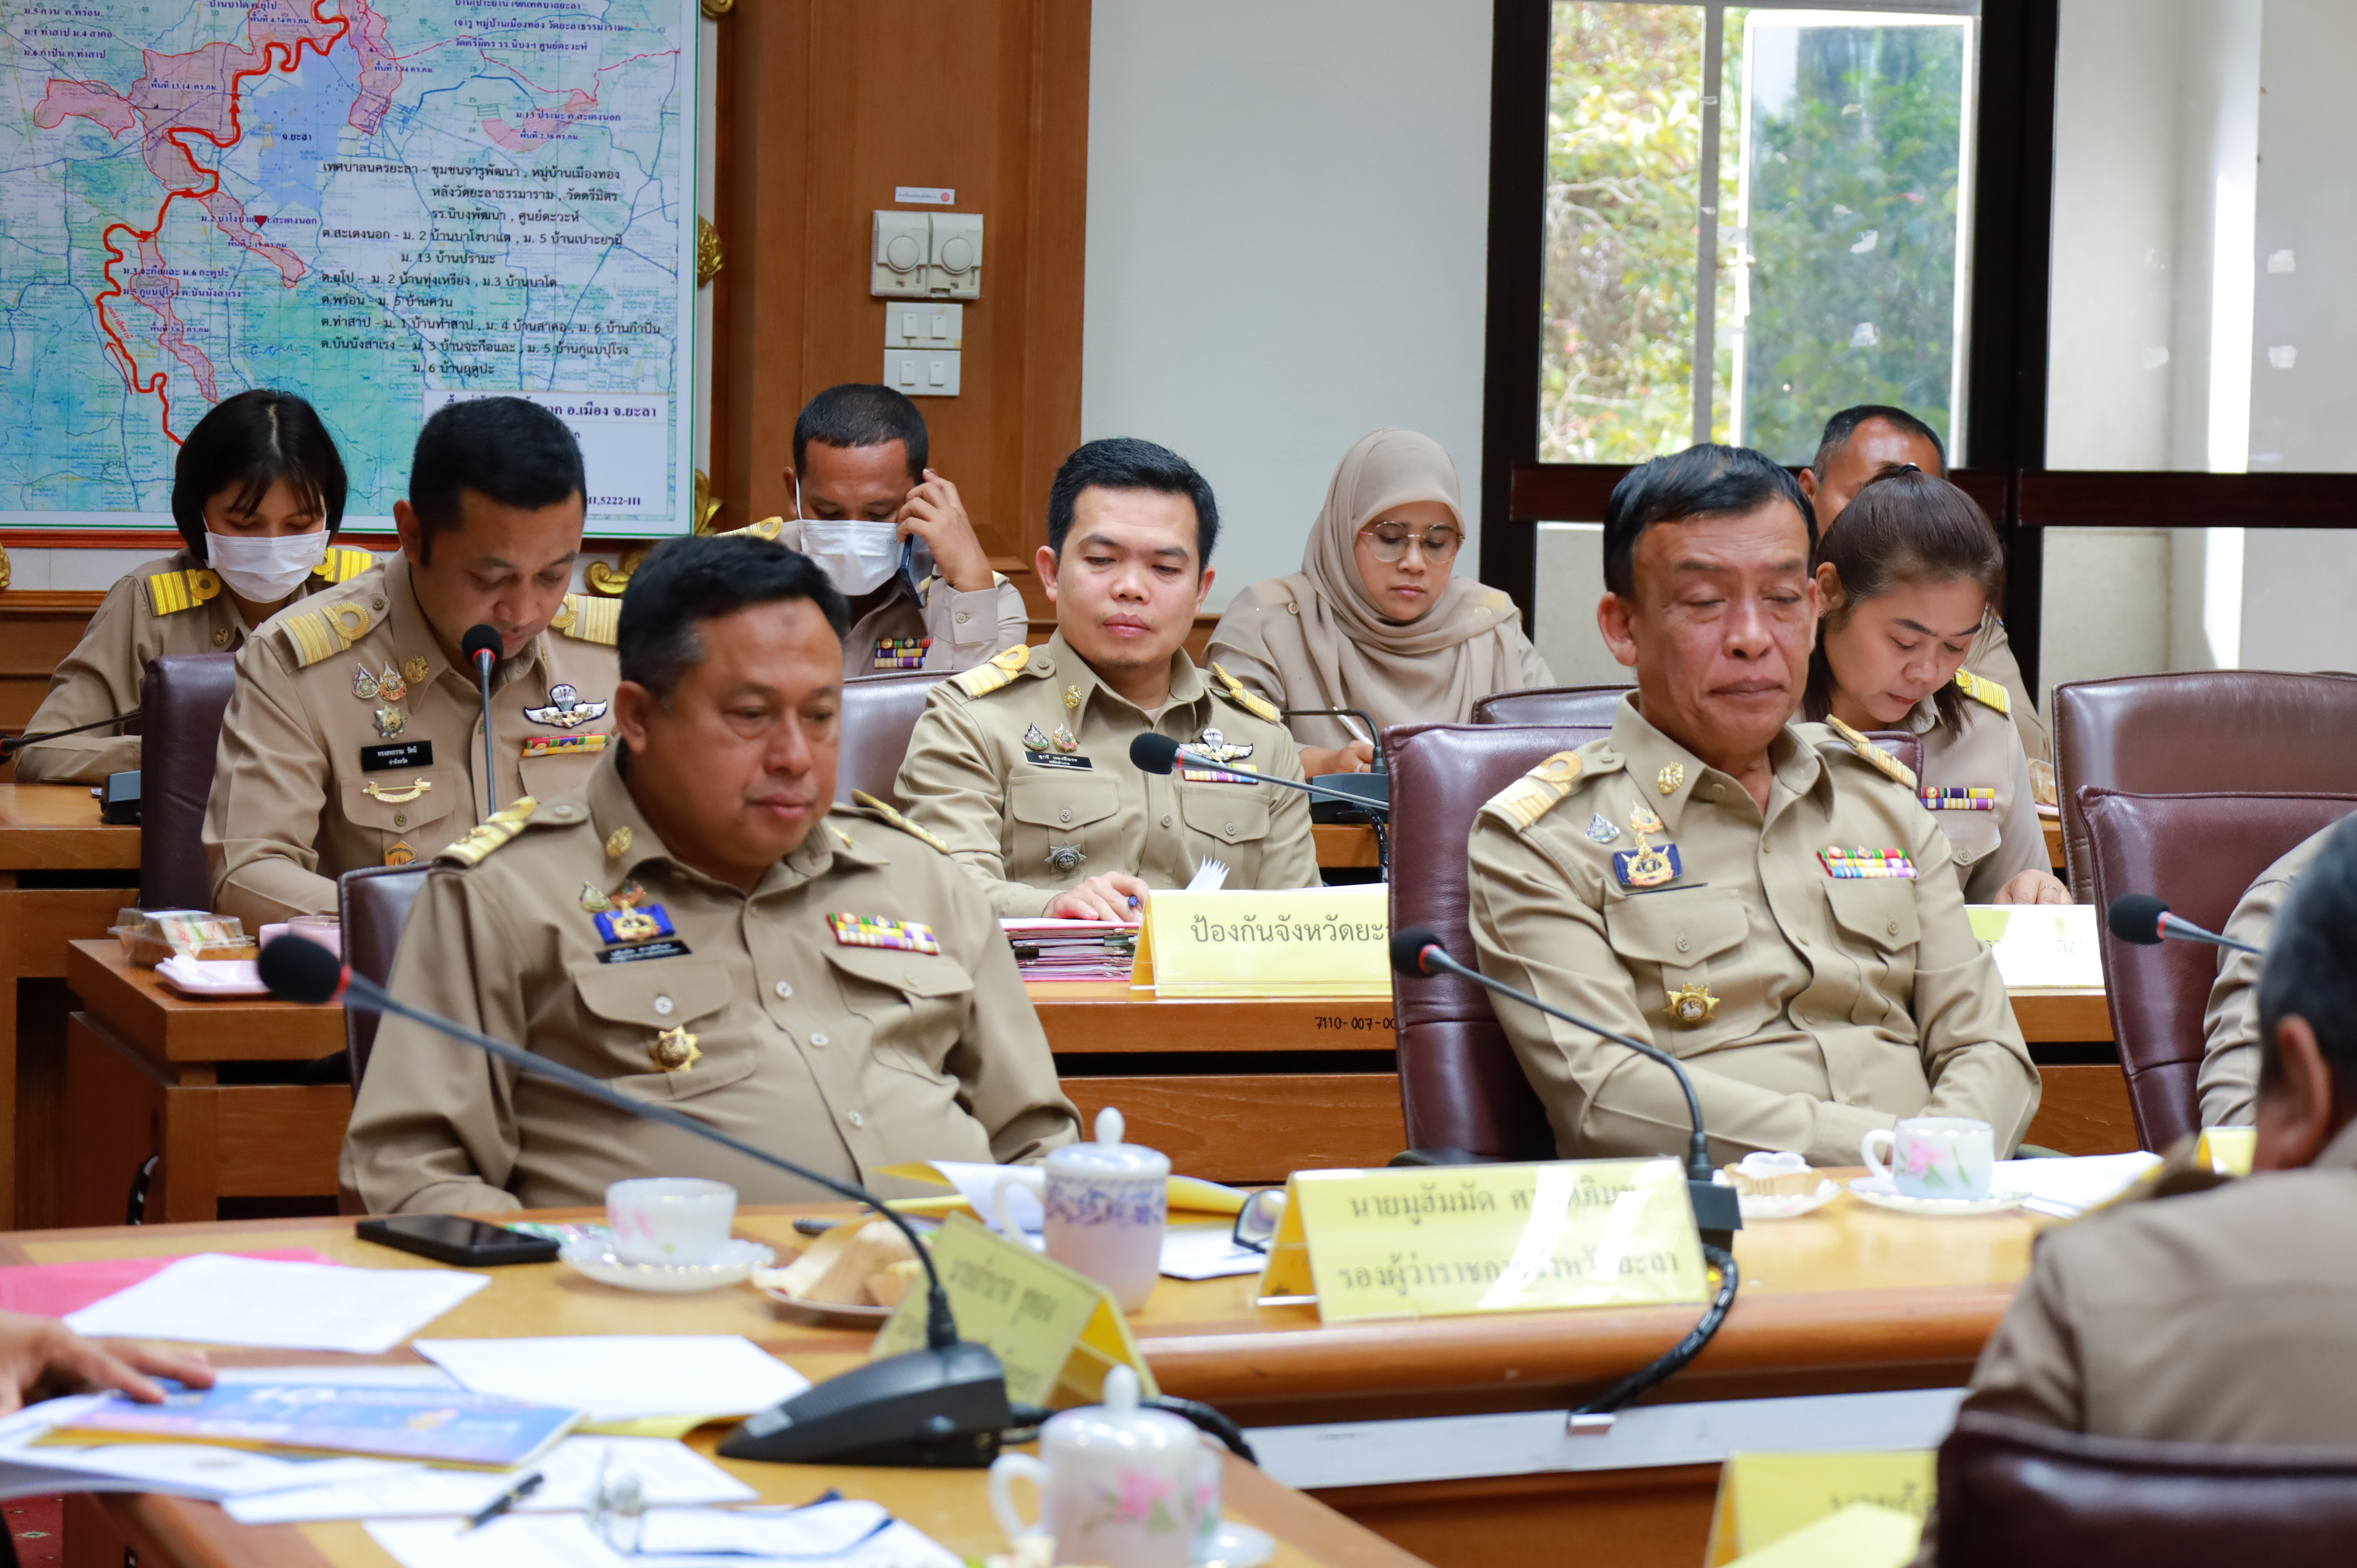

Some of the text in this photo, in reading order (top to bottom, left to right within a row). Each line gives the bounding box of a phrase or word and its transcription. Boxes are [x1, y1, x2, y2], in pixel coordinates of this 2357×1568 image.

[475, 18, 545, 29] หมู่บ้านเมืองทอง
[455, 37, 496, 48] วัดตรีมิตร
[323, 162, 620, 182] เทศบาลนครยะลา ชุมชนจารูพัฒนา หมู่บ้านเมืองทอง
[432, 184, 618, 202] หลังวัดยะลาธรรมาราม วัดตรีมิตร
[218, 212, 257, 223] บาโงบาแ
[432, 207, 579, 225] รร.นิบงพัฒนา ศูนย์ดะวะห์
[322, 229, 390, 239] ต.สะเตงนอก
[431, 228, 511, 242] บ้านบาโงบาแต
[539, 233, 547, 243] 5
[551, 231, 623, 245] บ้านเปาะยานี
[436, 250, 495, 264] บ้านปรามะ
[322, 270, 354, 286] ต.ยุโป
[388, 274, 395, 284] 2
[399, 271, 470, 288] บ้านทุ่งเหรียง
[505, 274, 557, 288] บ้านบาโด
[321, 293, 365, 305] ต.พร่อน
[405, 293, 453, 308] บ้านควน
[321, 315, 371, 327] ต.ท่าสาป
[411, 316, 473, 330] บ้านท่าสาป
[513, 318, 567, 332] บ้านสาคอ
[321, 336, 395, 350] ต.บันนังสาเรง
[543, 344, 551, 354] 5
[428, 363, 435, 373] 6
[567, 401, 609, 417] อ.เมือง
[613, 407, 657, 418] จ.ยะลา
[1190, 914, 1388, 942] ป้องกันจังหวัดยะ
[1347, 1178, 1496, 1226] นายมูฮัมมัด
